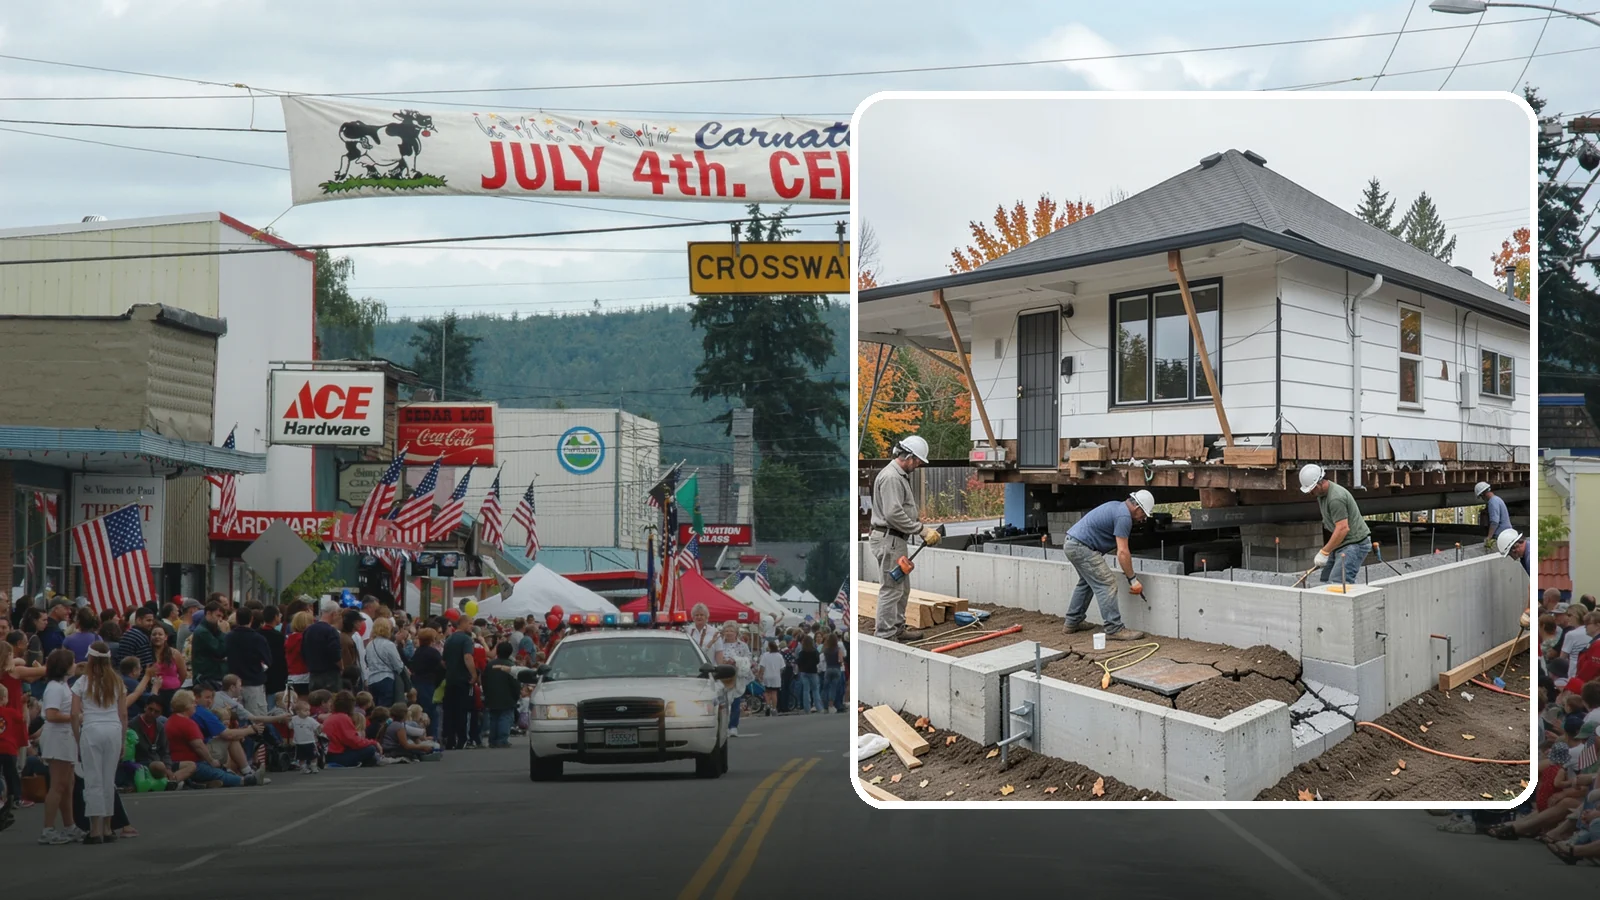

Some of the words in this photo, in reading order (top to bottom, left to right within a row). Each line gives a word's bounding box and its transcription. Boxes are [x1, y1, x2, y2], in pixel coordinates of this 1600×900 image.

[481, 140, 604, 192] JULY
[632, 150, 747, 197] 4th.
[283, 380, 373, 419] ACE
[405, 409, 452, 421] CEDAR
[283, 421, 371, 436] Hardware
[416, 428, 477, 446] Coca-Cola
[95, 485, 125, 494] Vincent
[126, 486, 136, 494] de
[138, 486, 155, 495] Paul
